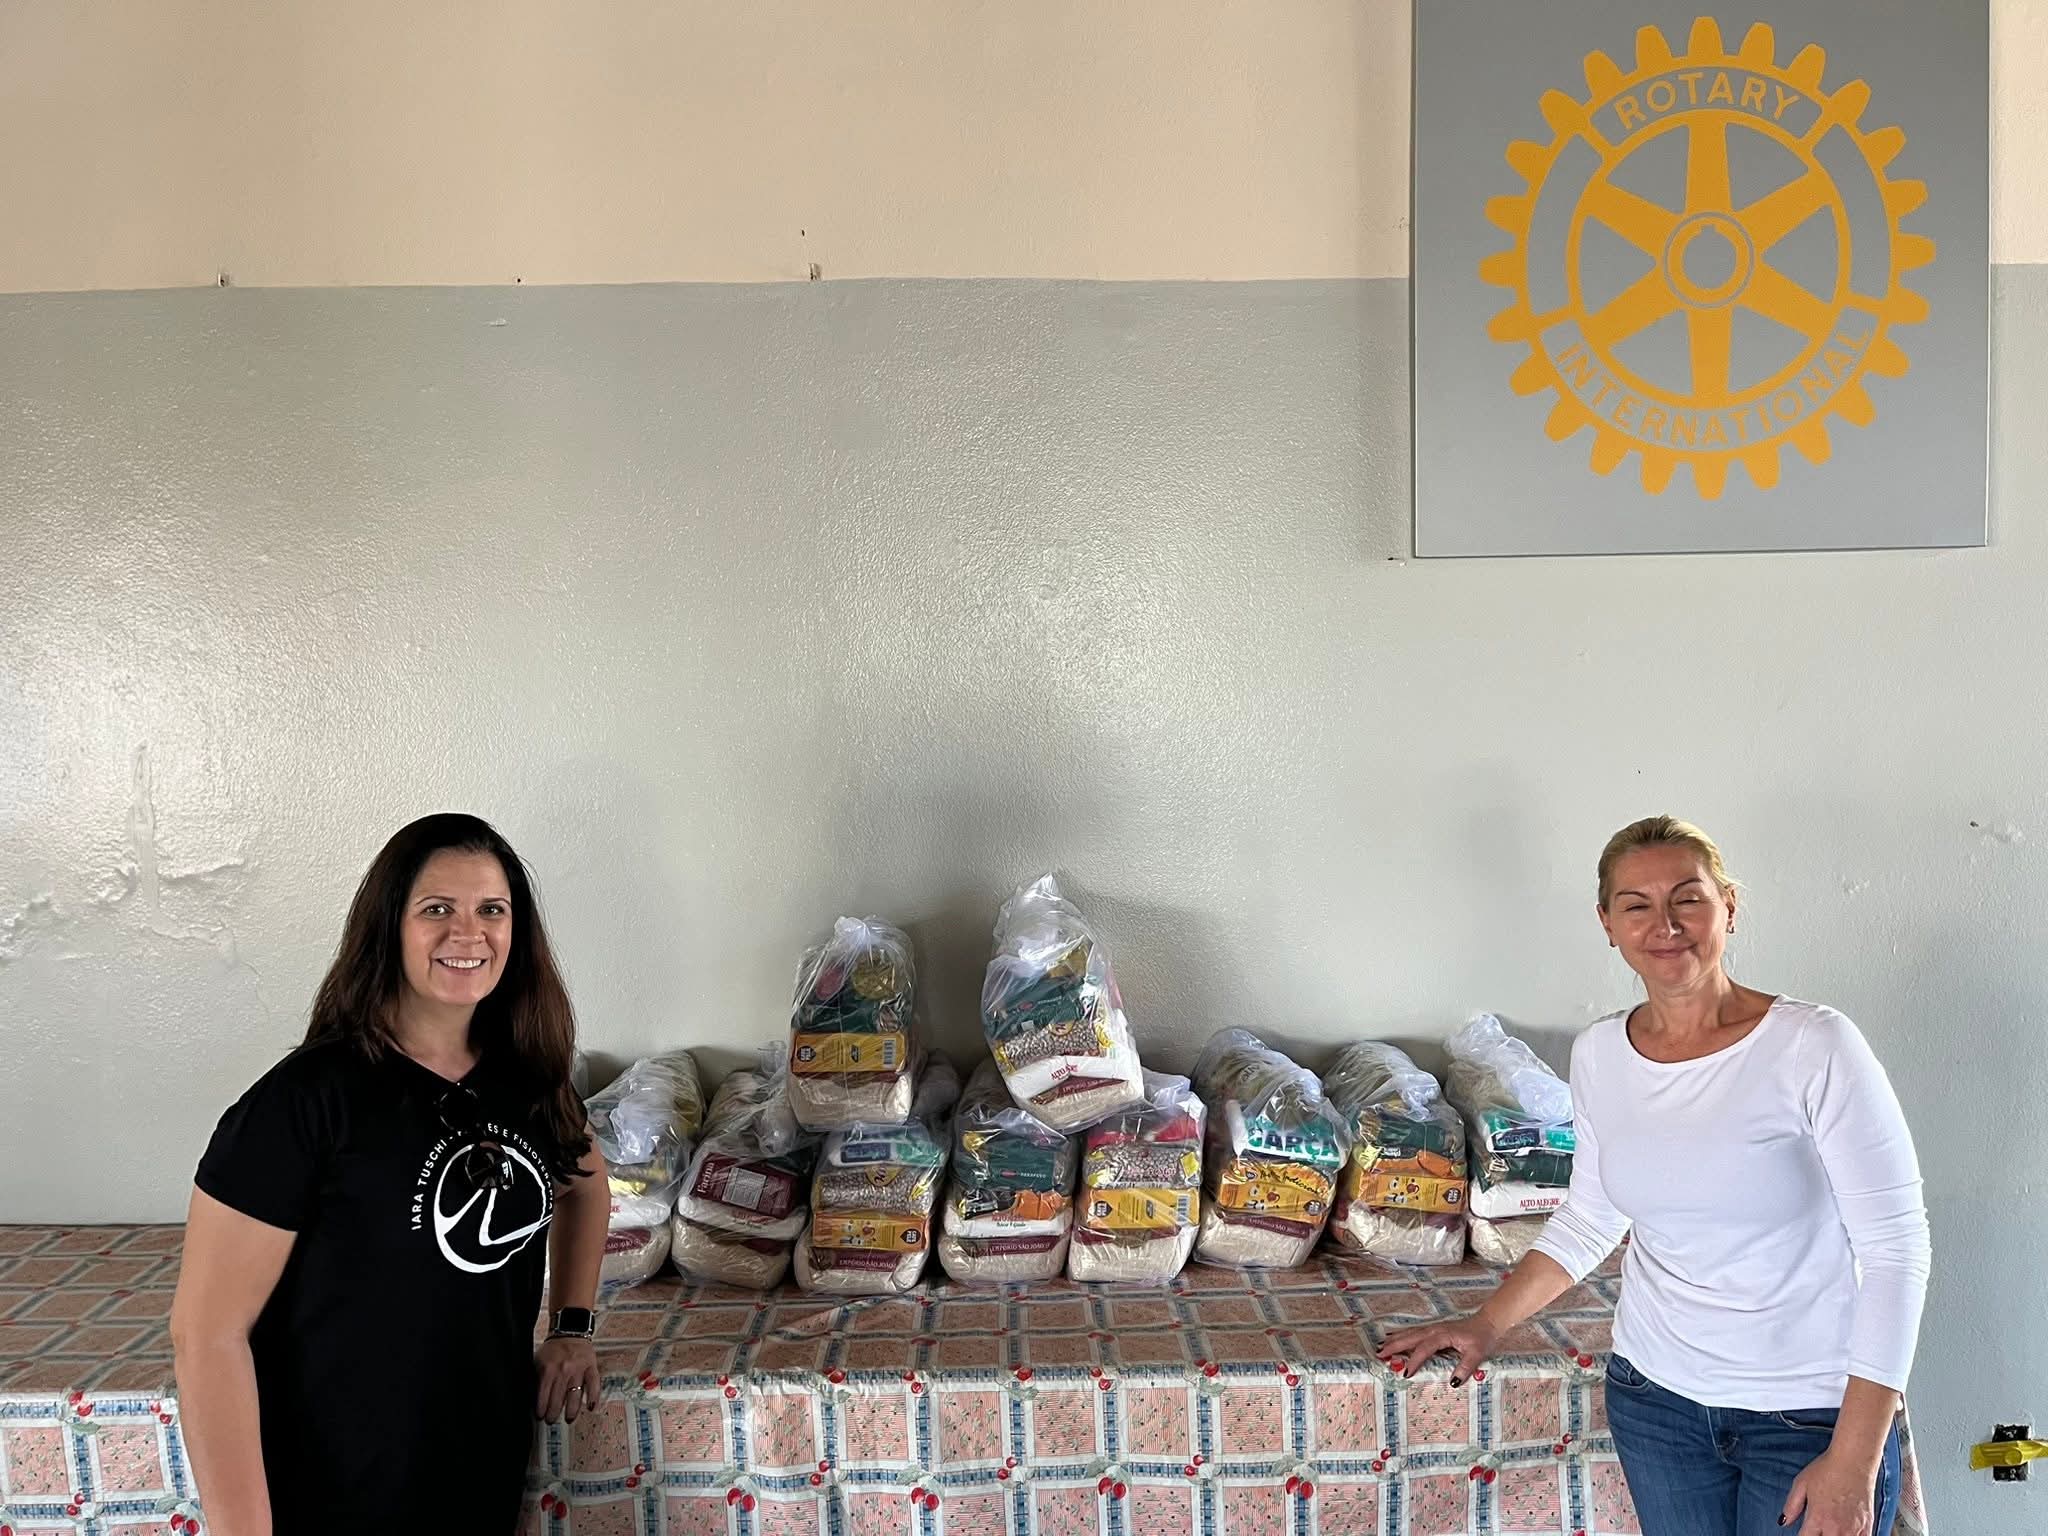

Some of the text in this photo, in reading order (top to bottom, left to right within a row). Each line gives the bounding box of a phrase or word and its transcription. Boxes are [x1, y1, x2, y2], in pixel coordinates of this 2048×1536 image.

[1613, 71, 1800, 130] ROTARY
[1556, 329, 1872, 447] INTERNATIONAL
[503, 1128, 509, 1137] E
[417, 1139, 448, 1187] TUSCHI
[697, 1161, 715, 1194] Farina
[411, 1193, 424, 1231] IARA
[1519, 1197, 1561, 1209] ALTO ALEGRE
